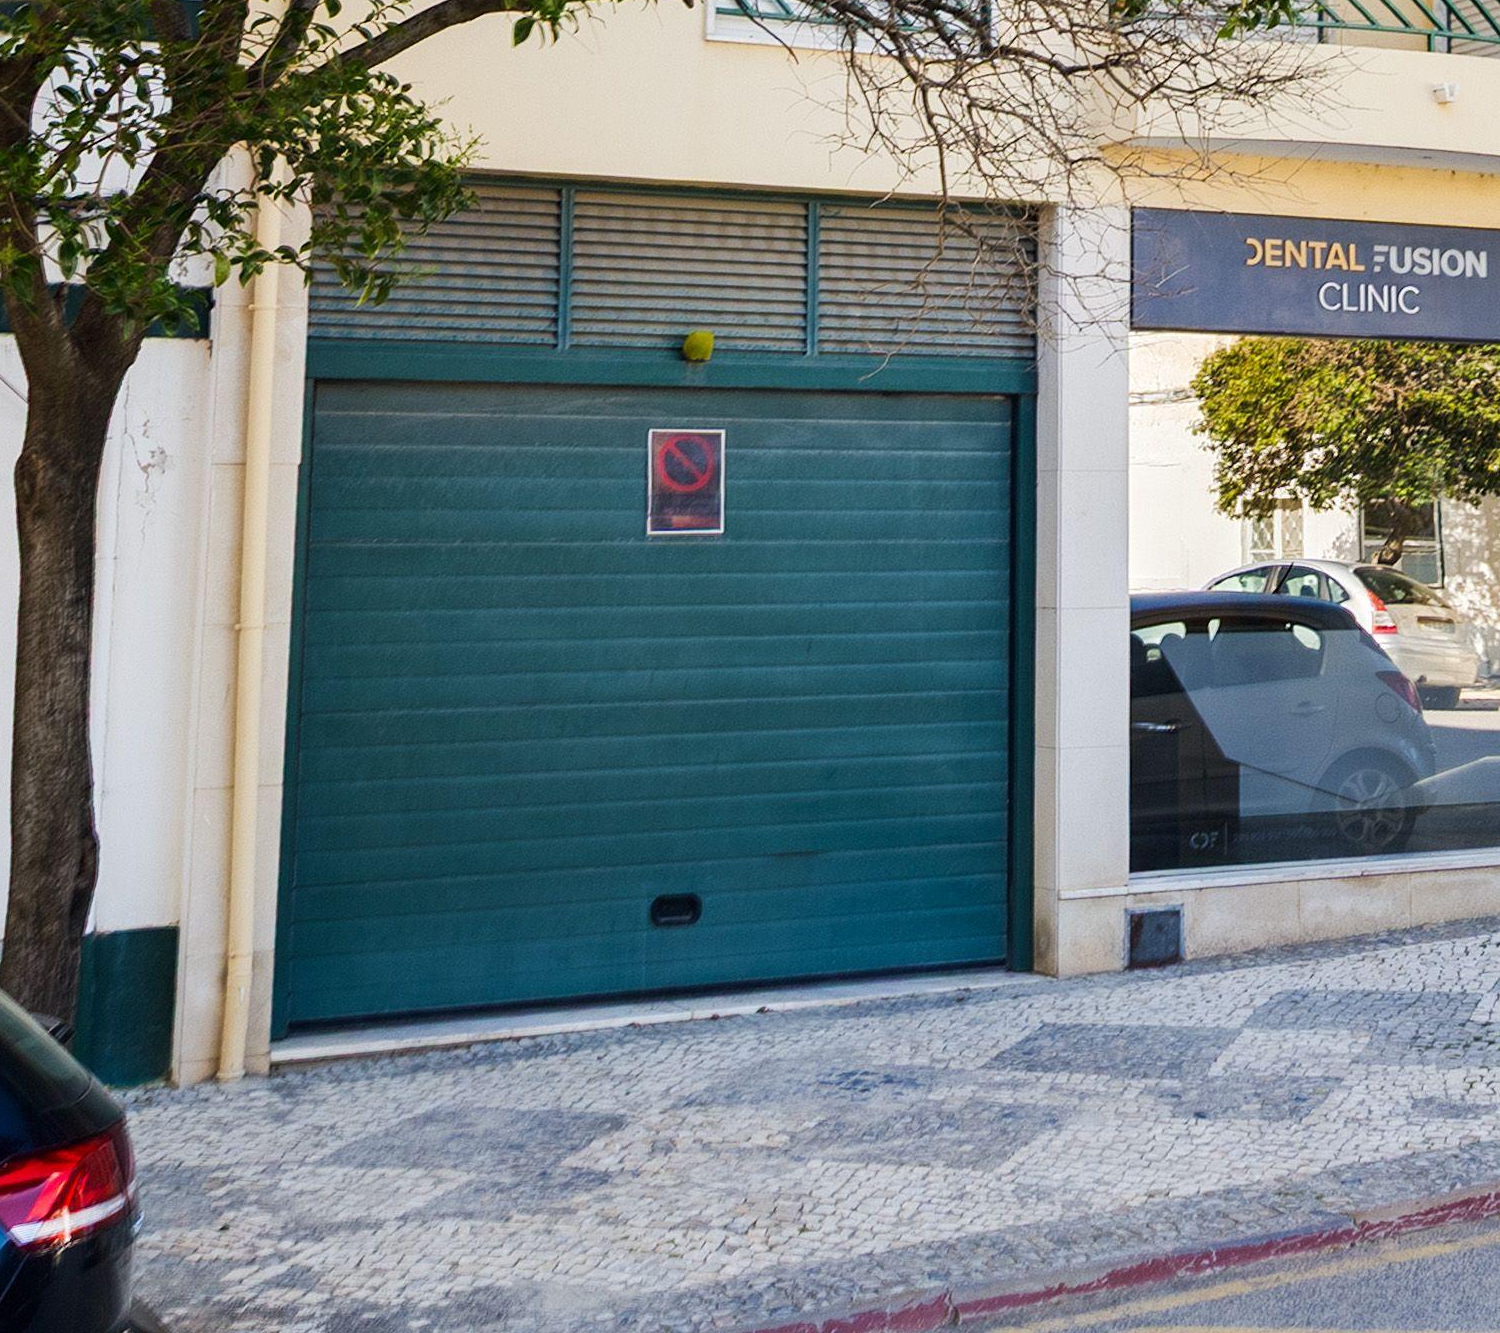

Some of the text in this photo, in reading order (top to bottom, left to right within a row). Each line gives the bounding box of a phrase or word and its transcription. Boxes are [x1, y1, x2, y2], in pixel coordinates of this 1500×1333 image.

[1246, 238, 1487, 278] DENTAL FUSION
[1318, 282, 1420, 314] CLINIC
